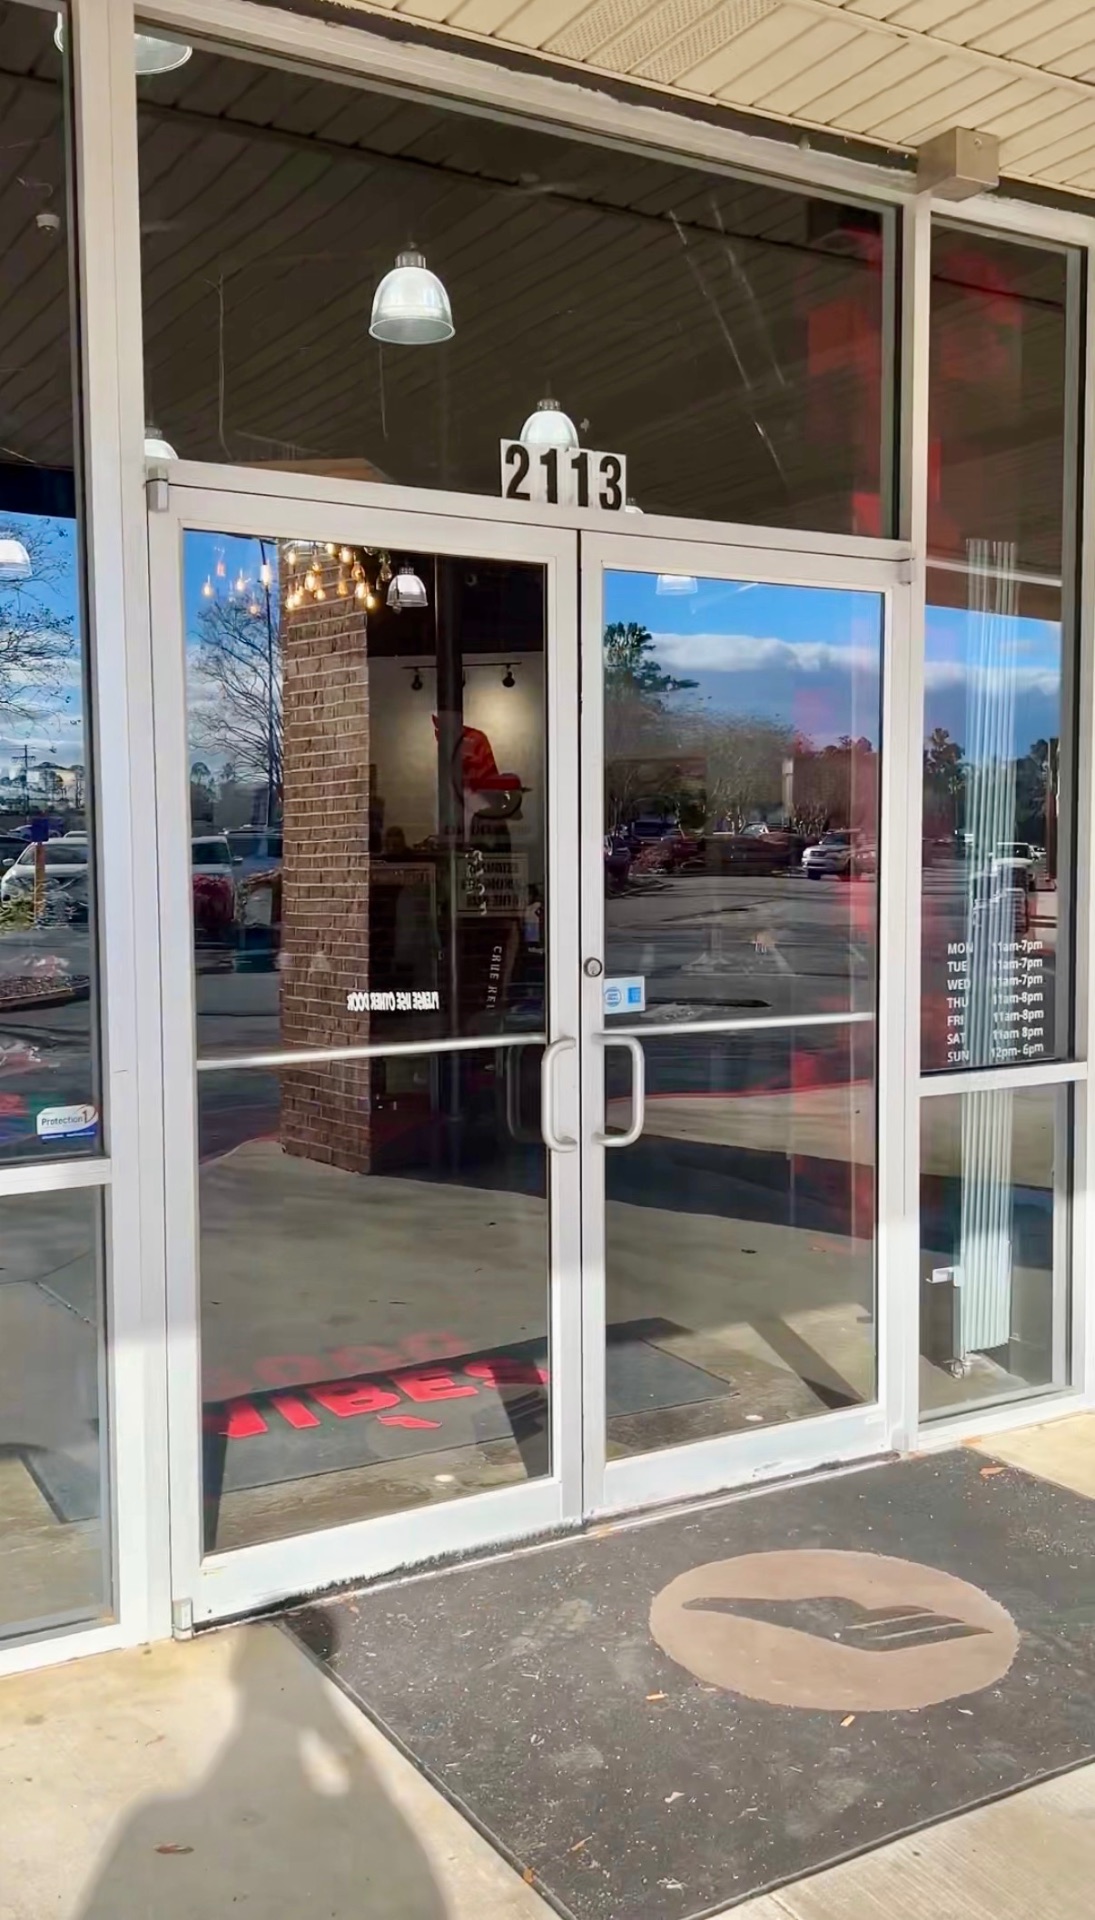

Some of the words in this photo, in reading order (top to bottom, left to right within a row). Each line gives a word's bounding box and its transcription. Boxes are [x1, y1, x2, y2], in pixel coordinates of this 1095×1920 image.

[505, 443, 623, 511] 2113
[947, 942, 974, 955] MON
[992, 940, 1043, 954] 11am-7pm
[947, 961, 968, 973] TUE
[992, 957, 1043, 971] 11am-7pm
[947, 979, 971, 990] WED
[992, 974, 1043, 988] 11am-7pm
[946, 997, 969, 1008] THU
[993, 992, 1043, 1005] 11am-8pm
[947, 1015, 964, 1026] FRI
[993, 1009, 1044, 1022] 11am-8pm
[947, 1033, 966, 1045] SAT
[947, 1050, 970, 1062] SUN
